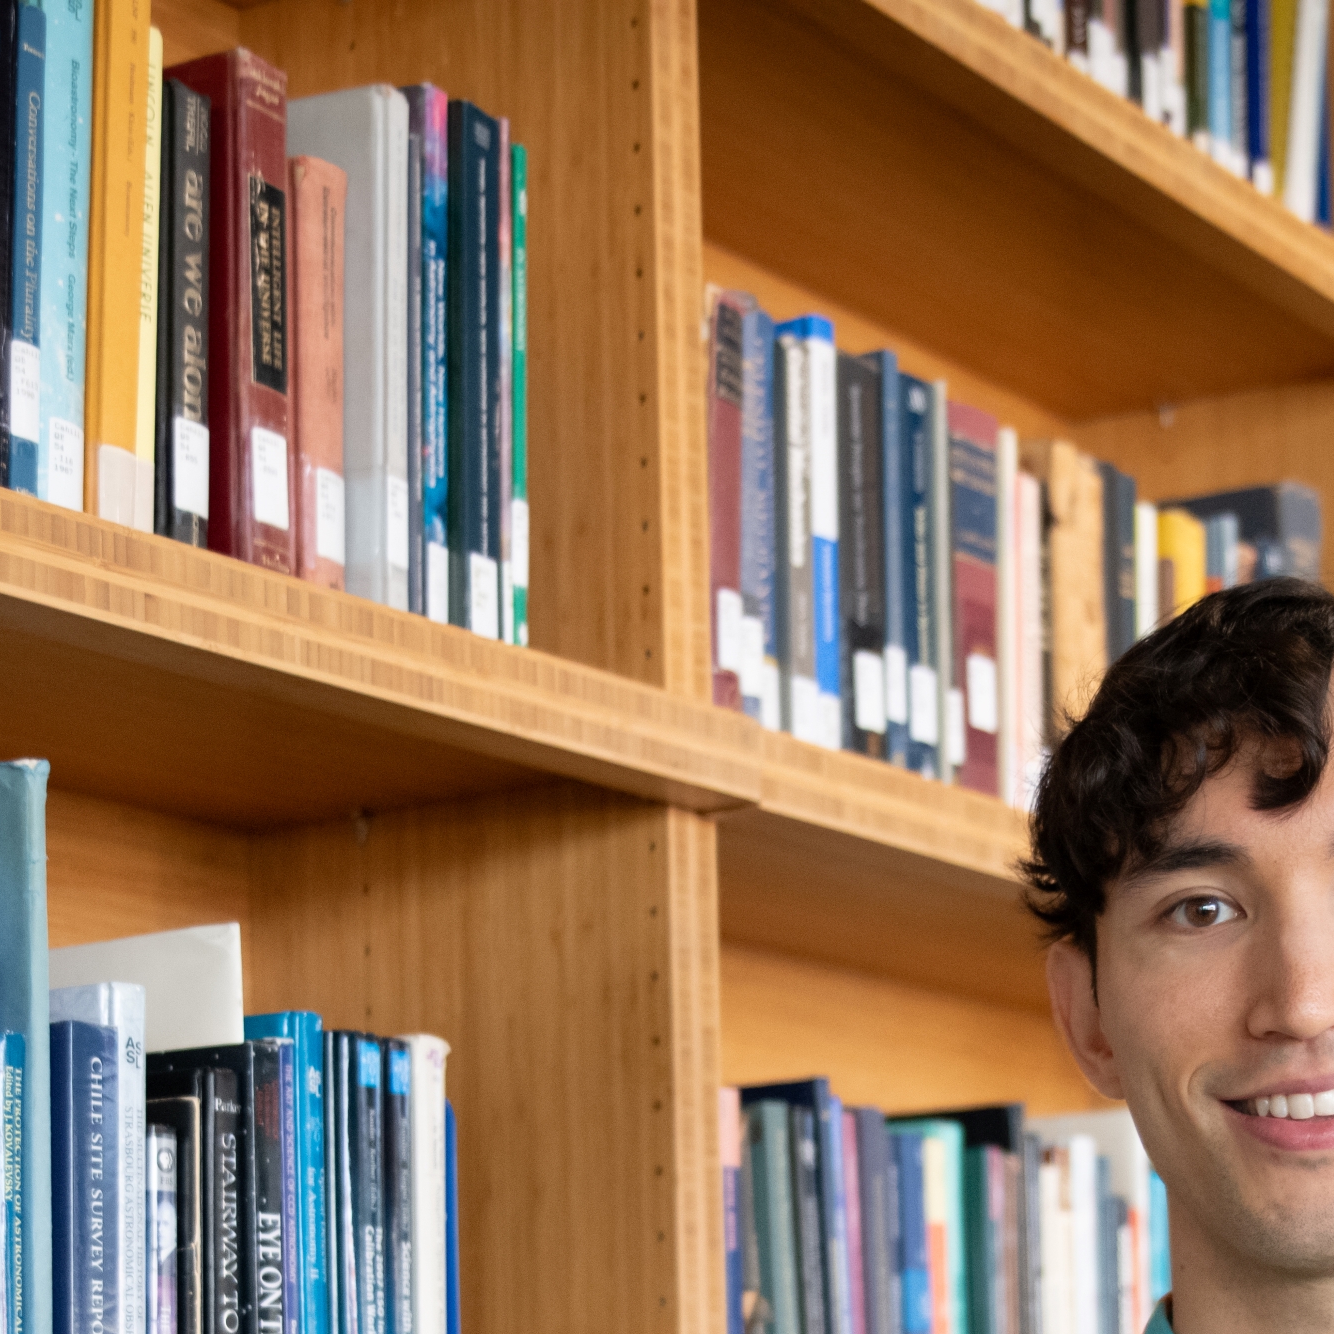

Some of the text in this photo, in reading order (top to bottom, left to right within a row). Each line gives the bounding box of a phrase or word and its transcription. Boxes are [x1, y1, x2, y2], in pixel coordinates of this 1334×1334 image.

[183, 169, 203, 241] are
[183, 252, 203, 317] we
[90, 1056, 103, 1125] CHILE
[90, 1132, 103, 1180] SITE
[90, 1187, 104, 1272] SURVEY
[221, 1131, 238, 1282] STAIRWAY
[257, 1211, 282, 1262] EYE
[223, 1291, 239, 1334] TO
[258, 1266, 283, 1310] ON
